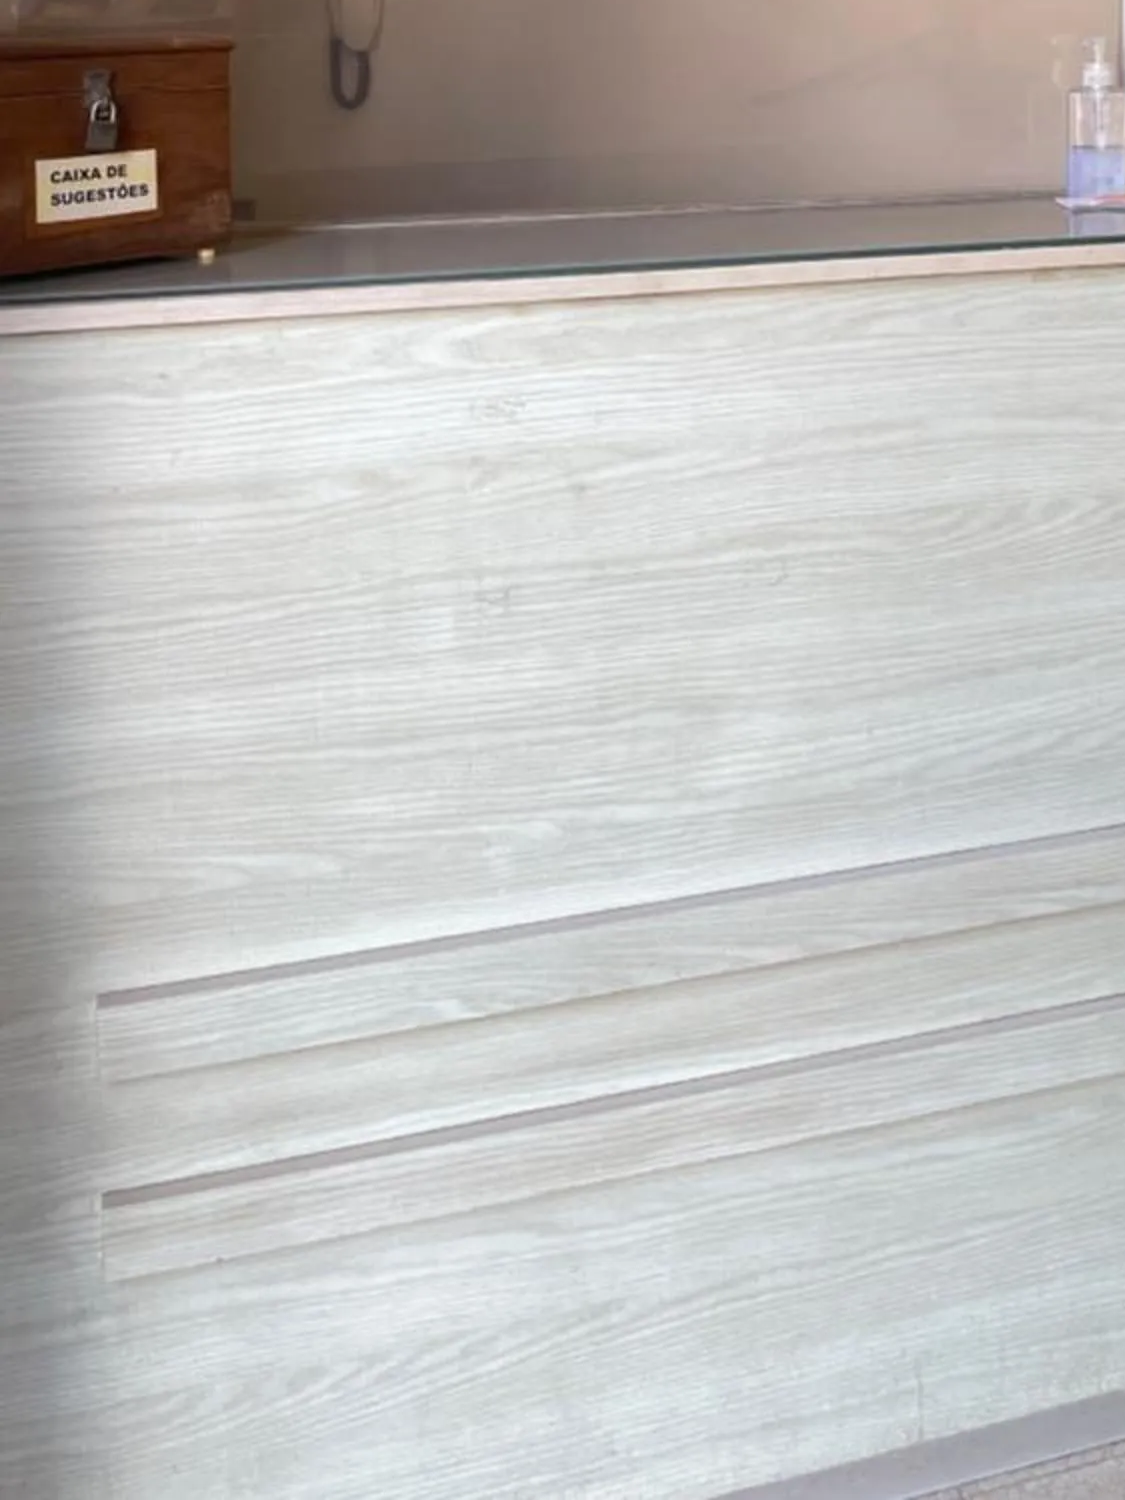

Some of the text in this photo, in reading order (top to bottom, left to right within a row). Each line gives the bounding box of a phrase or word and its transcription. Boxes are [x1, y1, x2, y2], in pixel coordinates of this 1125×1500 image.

[50, 164, 127, 184] CAIXA DE
[50, 183, 149, 207] SUGESTÕES
